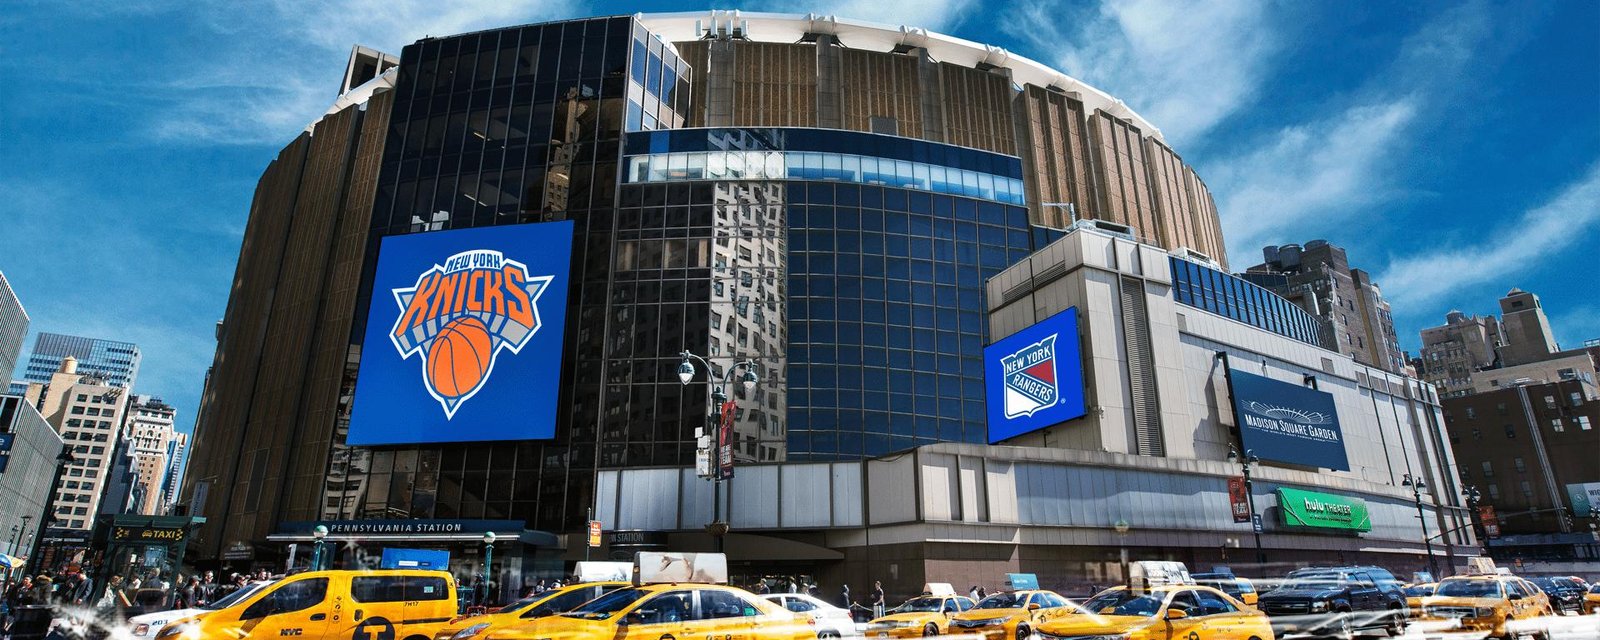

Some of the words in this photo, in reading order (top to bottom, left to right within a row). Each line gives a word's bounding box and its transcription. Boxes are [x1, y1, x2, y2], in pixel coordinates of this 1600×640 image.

[444, 253, 472, 273] NEW
[473, 252, 500, 271] YORK
[395, 265, 536, 337] KNICKS
[1006, 357, 1024, 373] NEW
[1027, 346, 1050, 364] YORK
[1013, 374, 1053, 401] RANGERS
[1245, 414, 1279, 431] MADISON
[1280, 420, 1308, 436] SQUARE
[1308, 425, 1338, 440] GARDEN
[1304, 497, 1325, 512] hulu
[1324, 502, 1352, 514] THEATER
[153, 530, 176, 539] TAXI
[330, 524, 412, 533] PENNSYLVANIA
[416, 523, 461, 532] STATION
[617, 532, 645, 543] STATION
[280, 628, 302, 637] NYC
